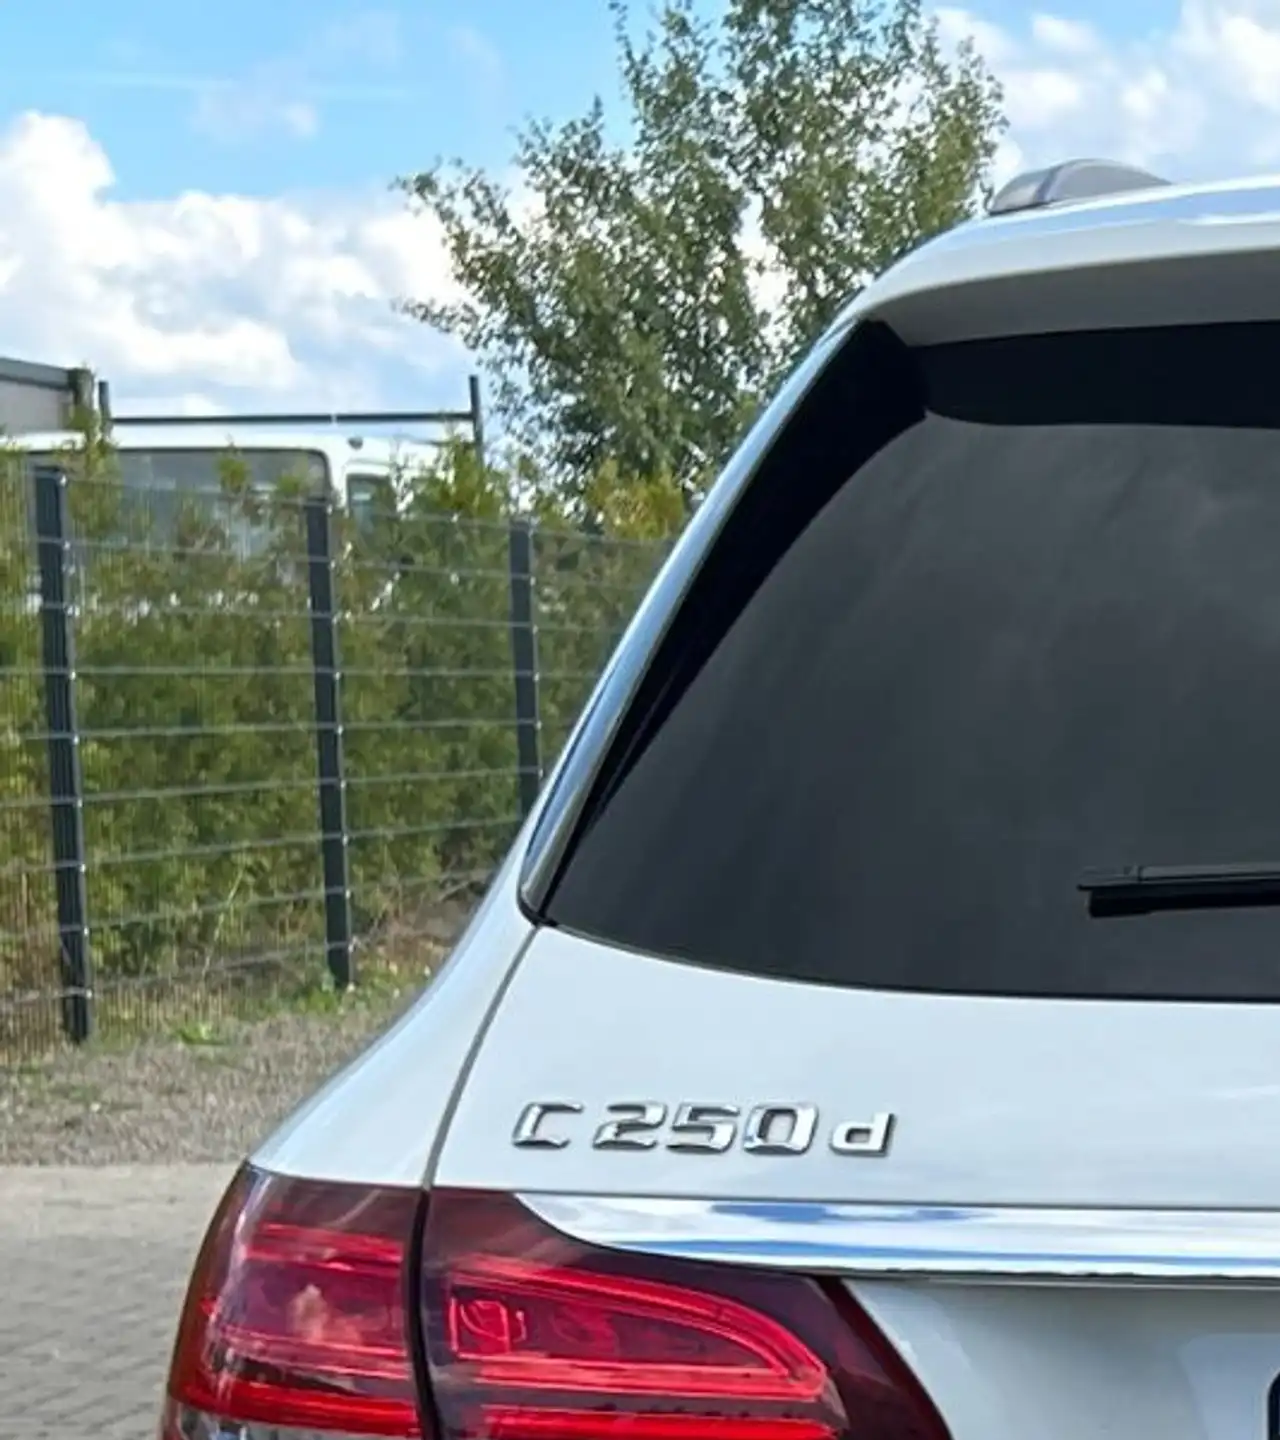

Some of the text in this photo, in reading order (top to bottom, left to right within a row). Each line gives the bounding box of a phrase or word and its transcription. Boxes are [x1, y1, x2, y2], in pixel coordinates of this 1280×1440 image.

[512, 1101, 898, 1157] C 250 d
